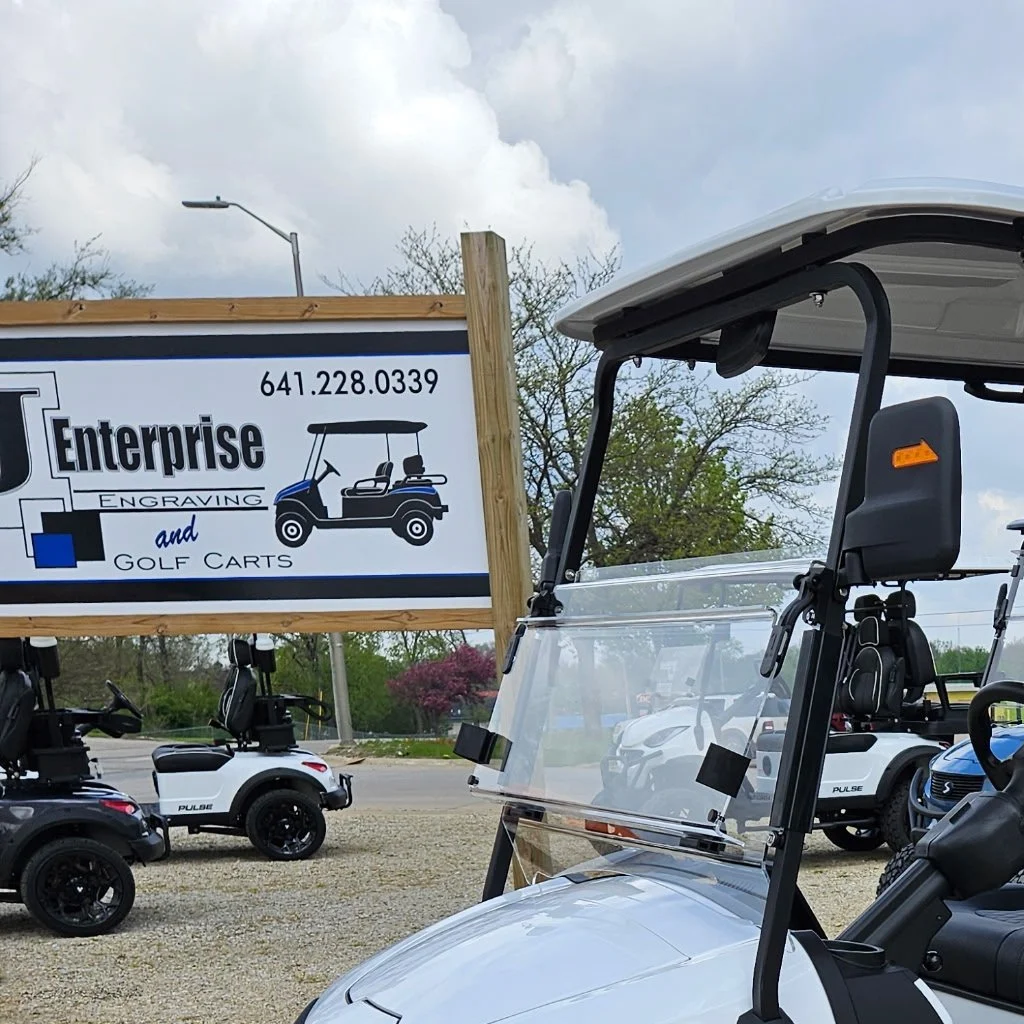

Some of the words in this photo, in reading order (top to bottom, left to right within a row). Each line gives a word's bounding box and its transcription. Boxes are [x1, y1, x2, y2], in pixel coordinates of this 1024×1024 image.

[260, 369, 439, 396] 641.228.0339
[50, 414, 266, 478] Enterprise
[99, 493, 263, 508] ENGRAVING
[155, 514, 199, 548] and
[113, 553, 190, 571] GOLF
[203, 552, 293, 570] CARTS
[832, 785, 864, 793] PULSE
[178, 803, 214, 811] PULSE
